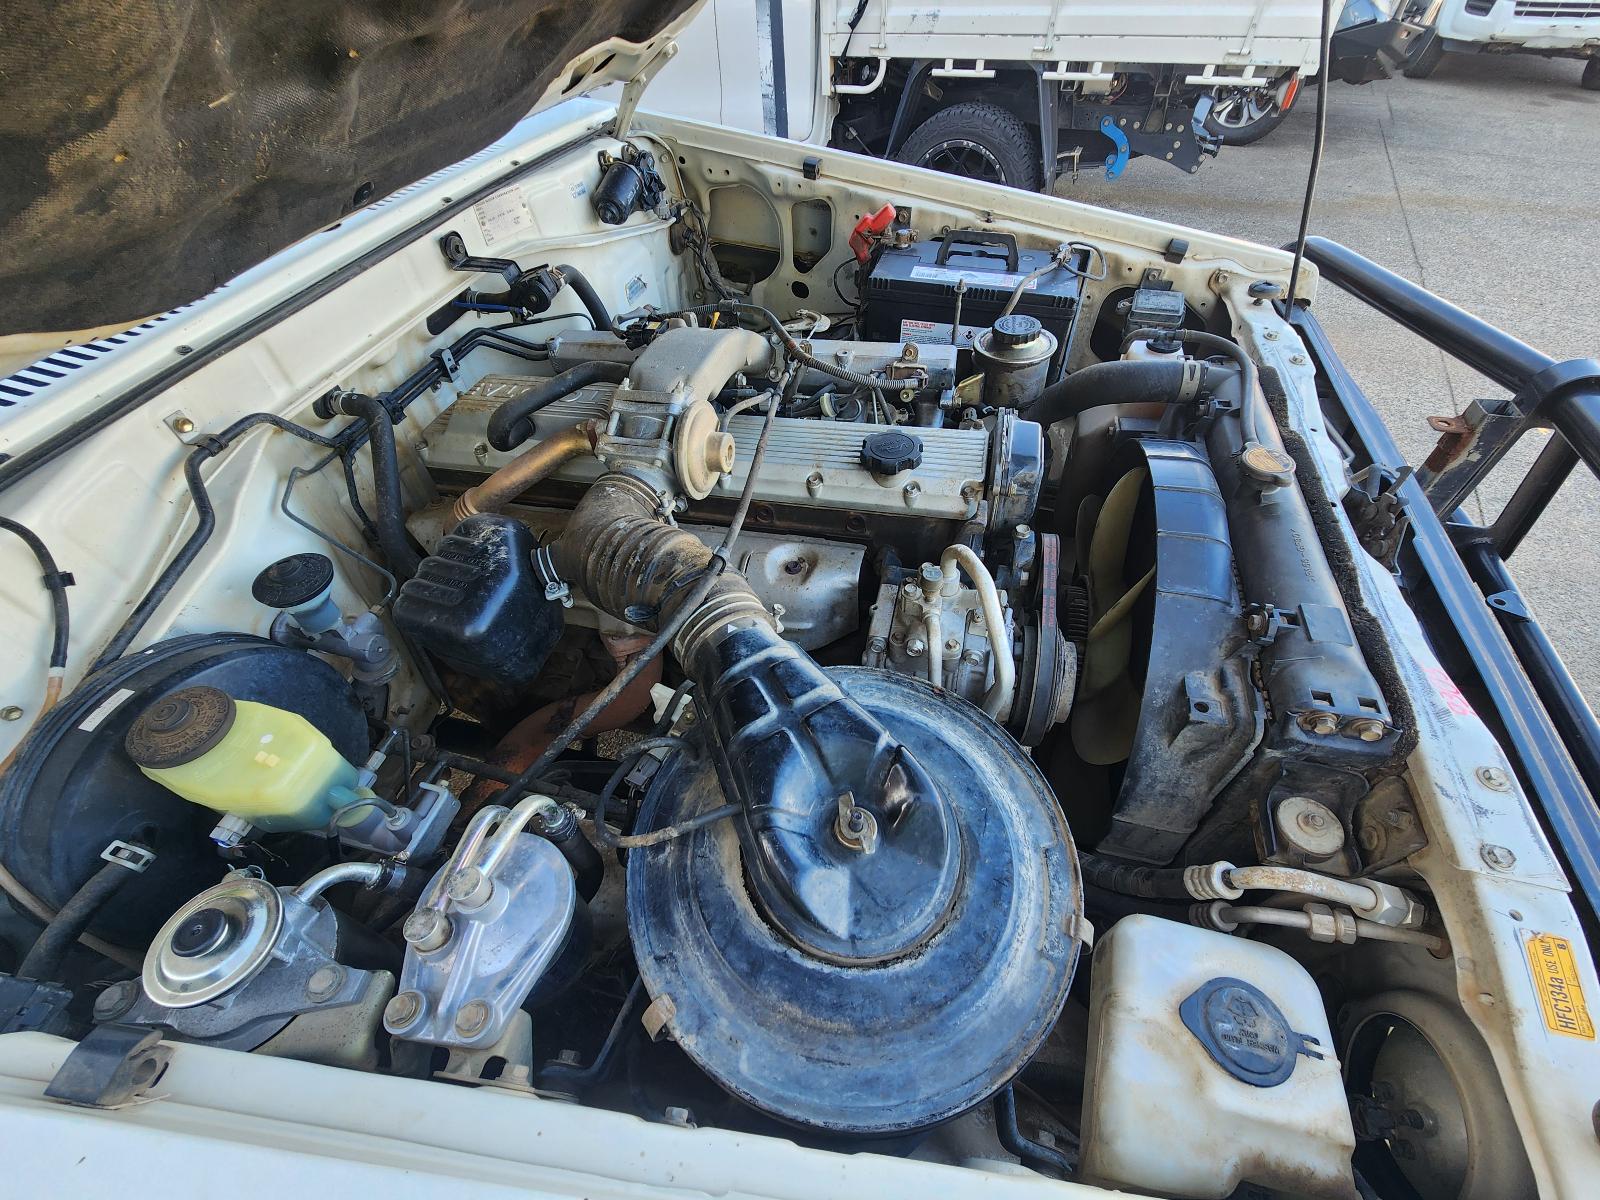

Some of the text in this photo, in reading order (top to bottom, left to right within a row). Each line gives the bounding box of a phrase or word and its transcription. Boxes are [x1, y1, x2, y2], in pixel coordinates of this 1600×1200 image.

[1539, 937, 1555, 957] ONLY
[1545, 960, 1559, 974] USE
[1548, 978, 1577, 1030] HFC134a
